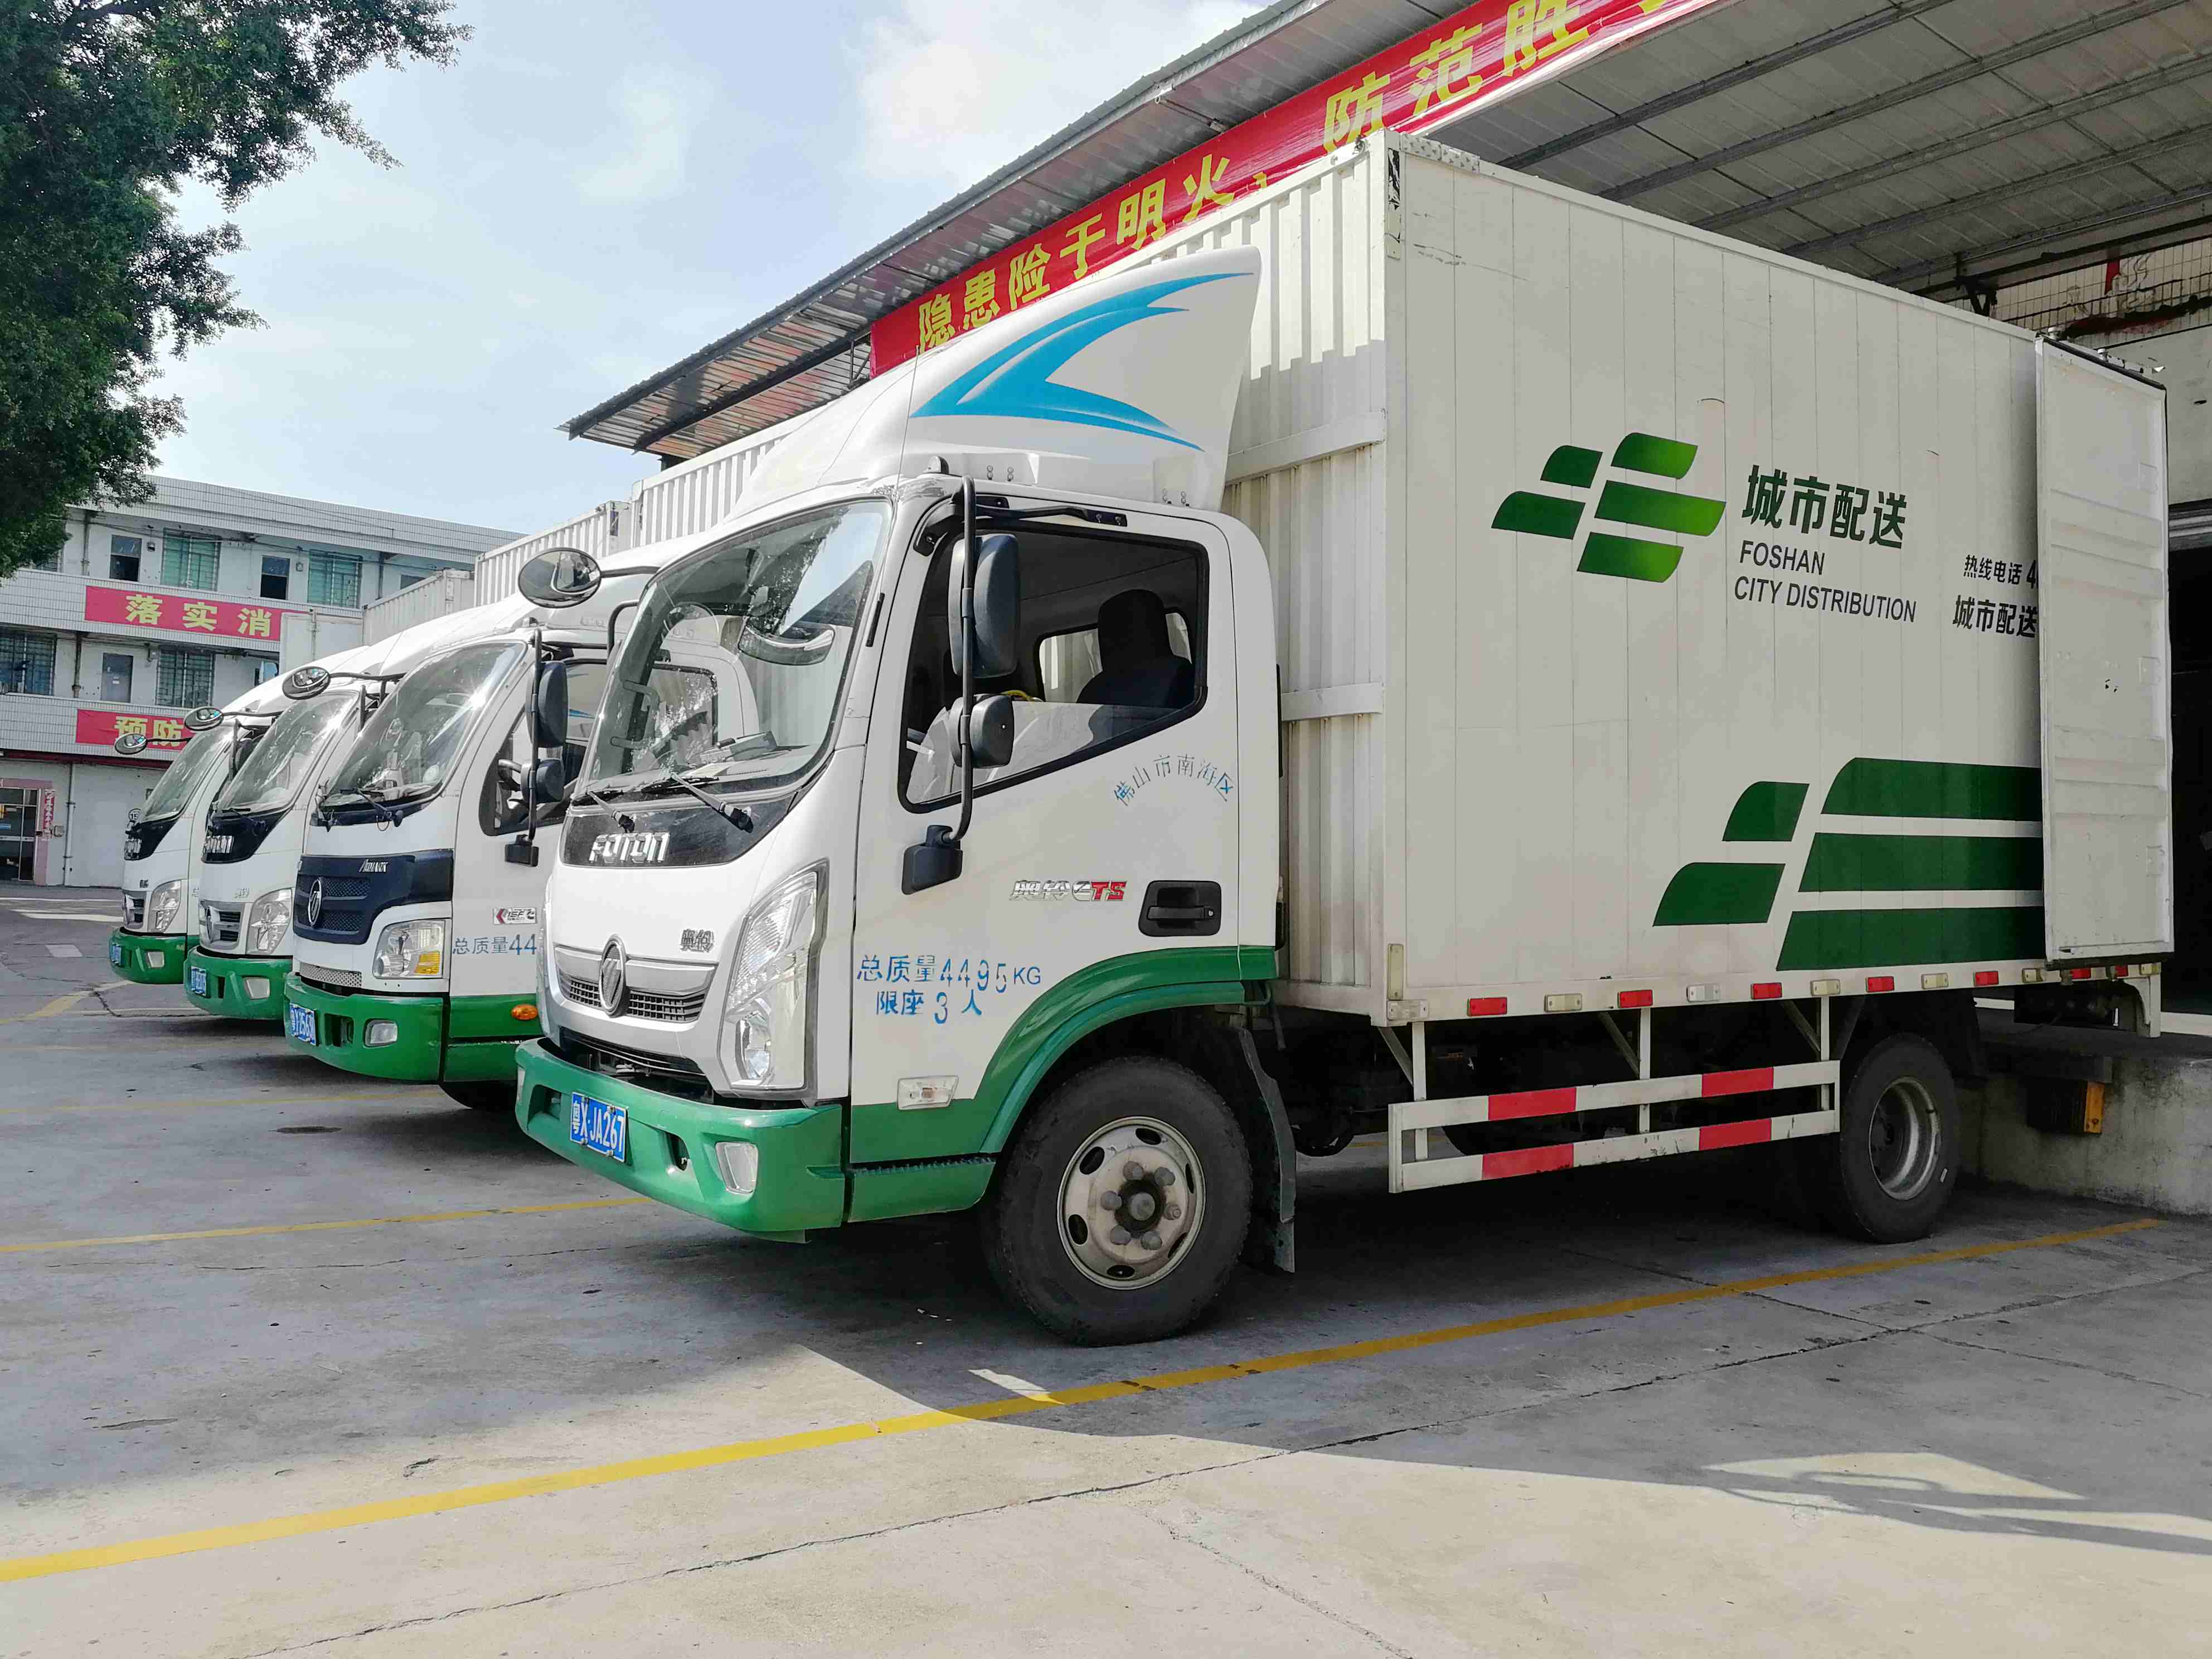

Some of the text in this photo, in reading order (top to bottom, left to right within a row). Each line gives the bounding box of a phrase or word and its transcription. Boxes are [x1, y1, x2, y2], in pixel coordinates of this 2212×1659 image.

[1742, 464, 1908, 549] 城市配送
[1739, 540, 1825, 575] FOSHAN
[1963, 554, 2023, 585] 热线电话
[125, 594, 271, 637] 落实消
[1734, 576, 1917, 623] CITY DISTRIBUTION
[1952, 594, 2038, 638] 城市配送
[589, 832, 670, 864] FOTON
